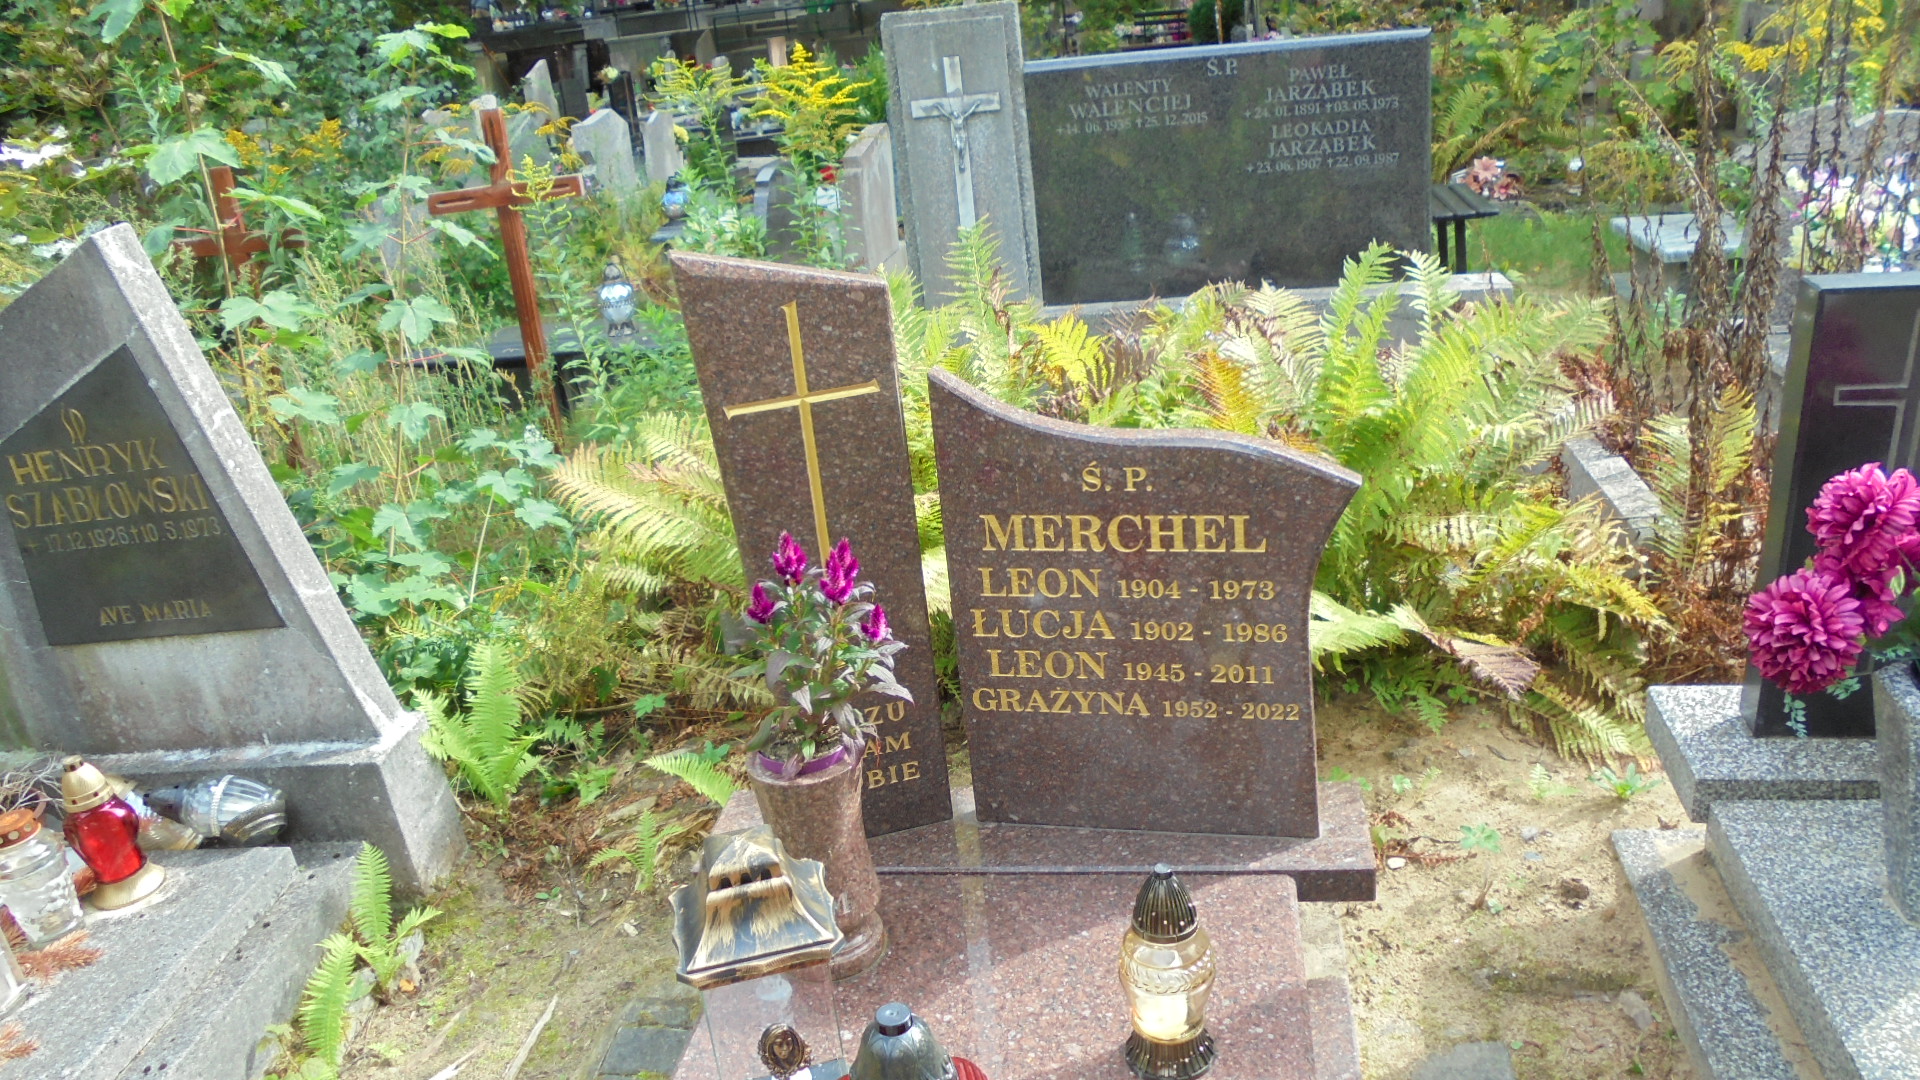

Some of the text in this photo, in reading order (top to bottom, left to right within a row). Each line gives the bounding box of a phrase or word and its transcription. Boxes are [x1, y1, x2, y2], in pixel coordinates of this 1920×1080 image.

[1084, 77, 1173, 99] WALENTY
[1069, 94, 1191, 120] WALENCIEJ
[1271, 119, 1371, 139] LEOKADIA
[6, 437, 168, 486] HENRYK
[979, 514, 1266, 553] MERCHEL
[977, 567, 1102, 598] LEON
[1118, 579, 1181, 600] 1904
[1209, 580, 1276, 600] 1973
[100, 599, 213, 627] AVE MARIA
[970, 608, 1115, 640] ŁUCJA
[1130, 621, 1194, 641] 1902
[1222, 623, 1288, 643] 1986
[987, 649, 1108, 680] LEON
[1122, 662, 1186, 682] 1945
[1210, 664, 1274, 684] 2011
[864, 700, 905, 725] ZU
[972, 686, 1150, 716] GRAŻYNA
[1162, 700, 1218, 718] 1952
[1241, 702, 1300, 721] 2022
[862, 731, 911, 758] AM
[866, 760, 920, 790] BIE
